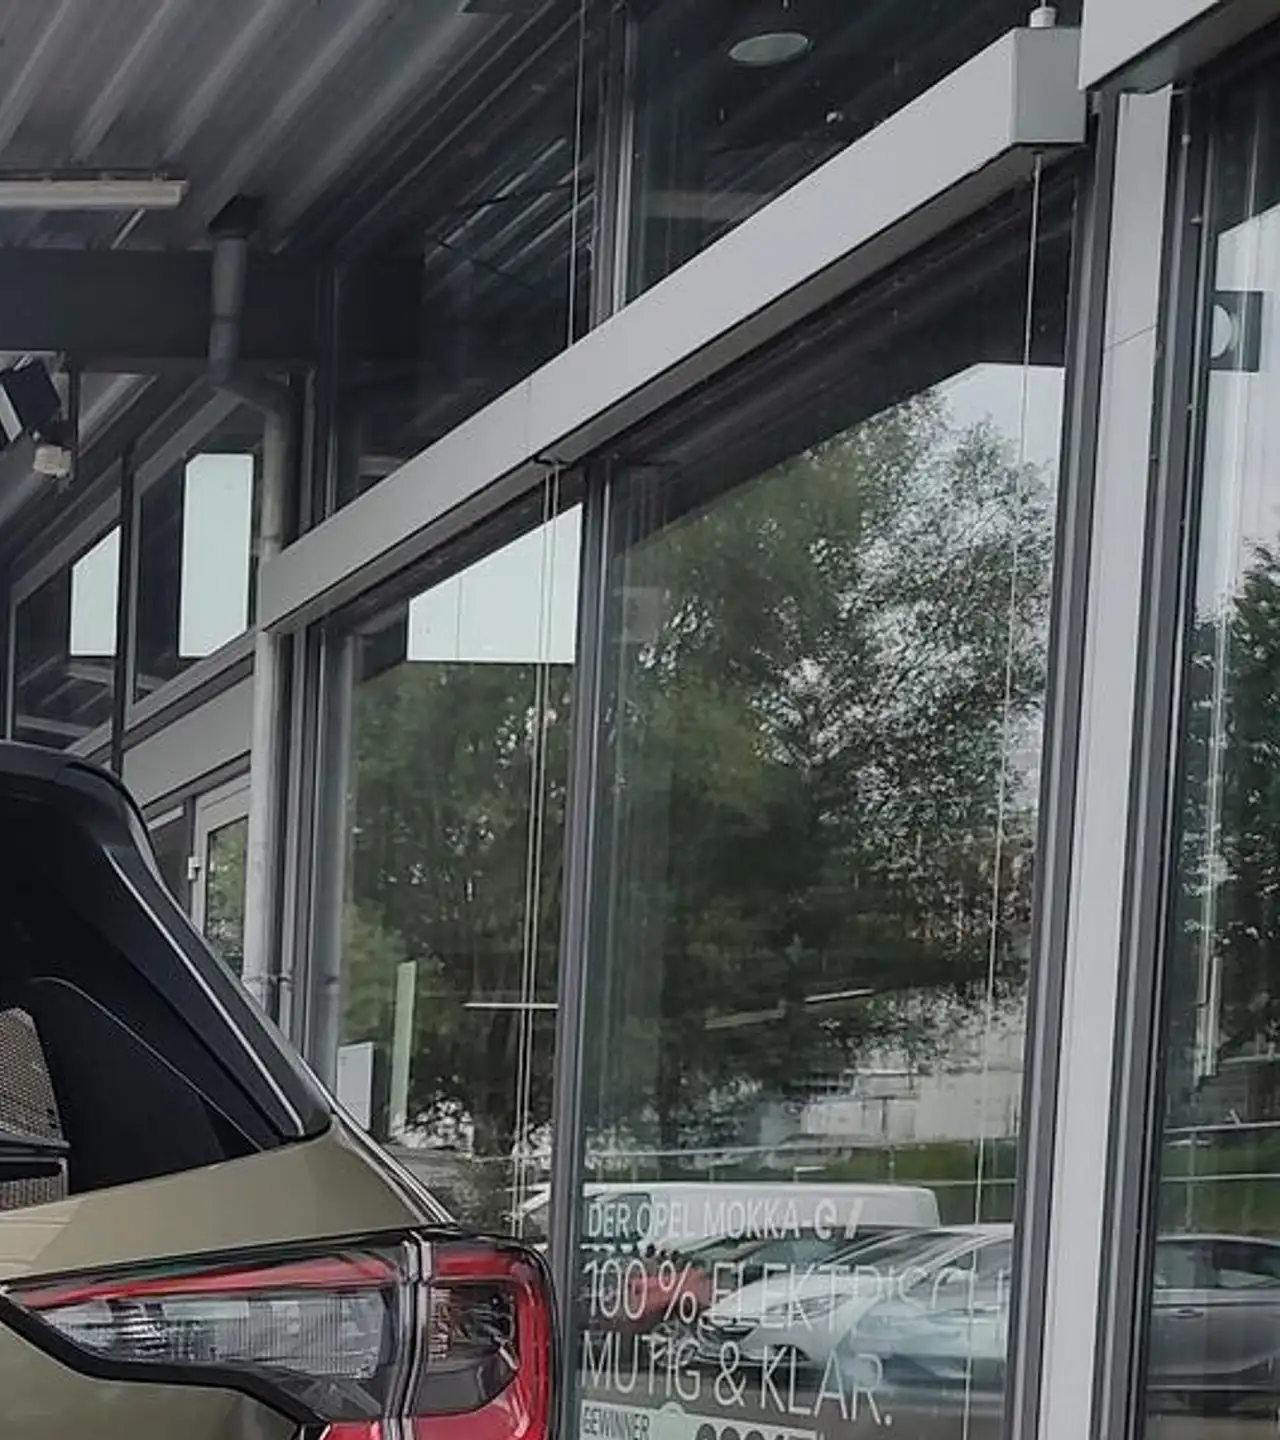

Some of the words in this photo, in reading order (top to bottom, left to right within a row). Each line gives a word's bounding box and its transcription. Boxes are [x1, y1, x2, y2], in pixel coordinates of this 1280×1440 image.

[588, 1199, 630, 1238] DER
[635, 1199, 696, 1239] OPEL
[582, 1259, 646, 1320] 100
[657, 1261, 696, 1325] %
[580, 1330, 701, 1401] MUTIG
[714, 1341, 747, 1408] &
[760, 1344, 893, 1428] KLAR.
